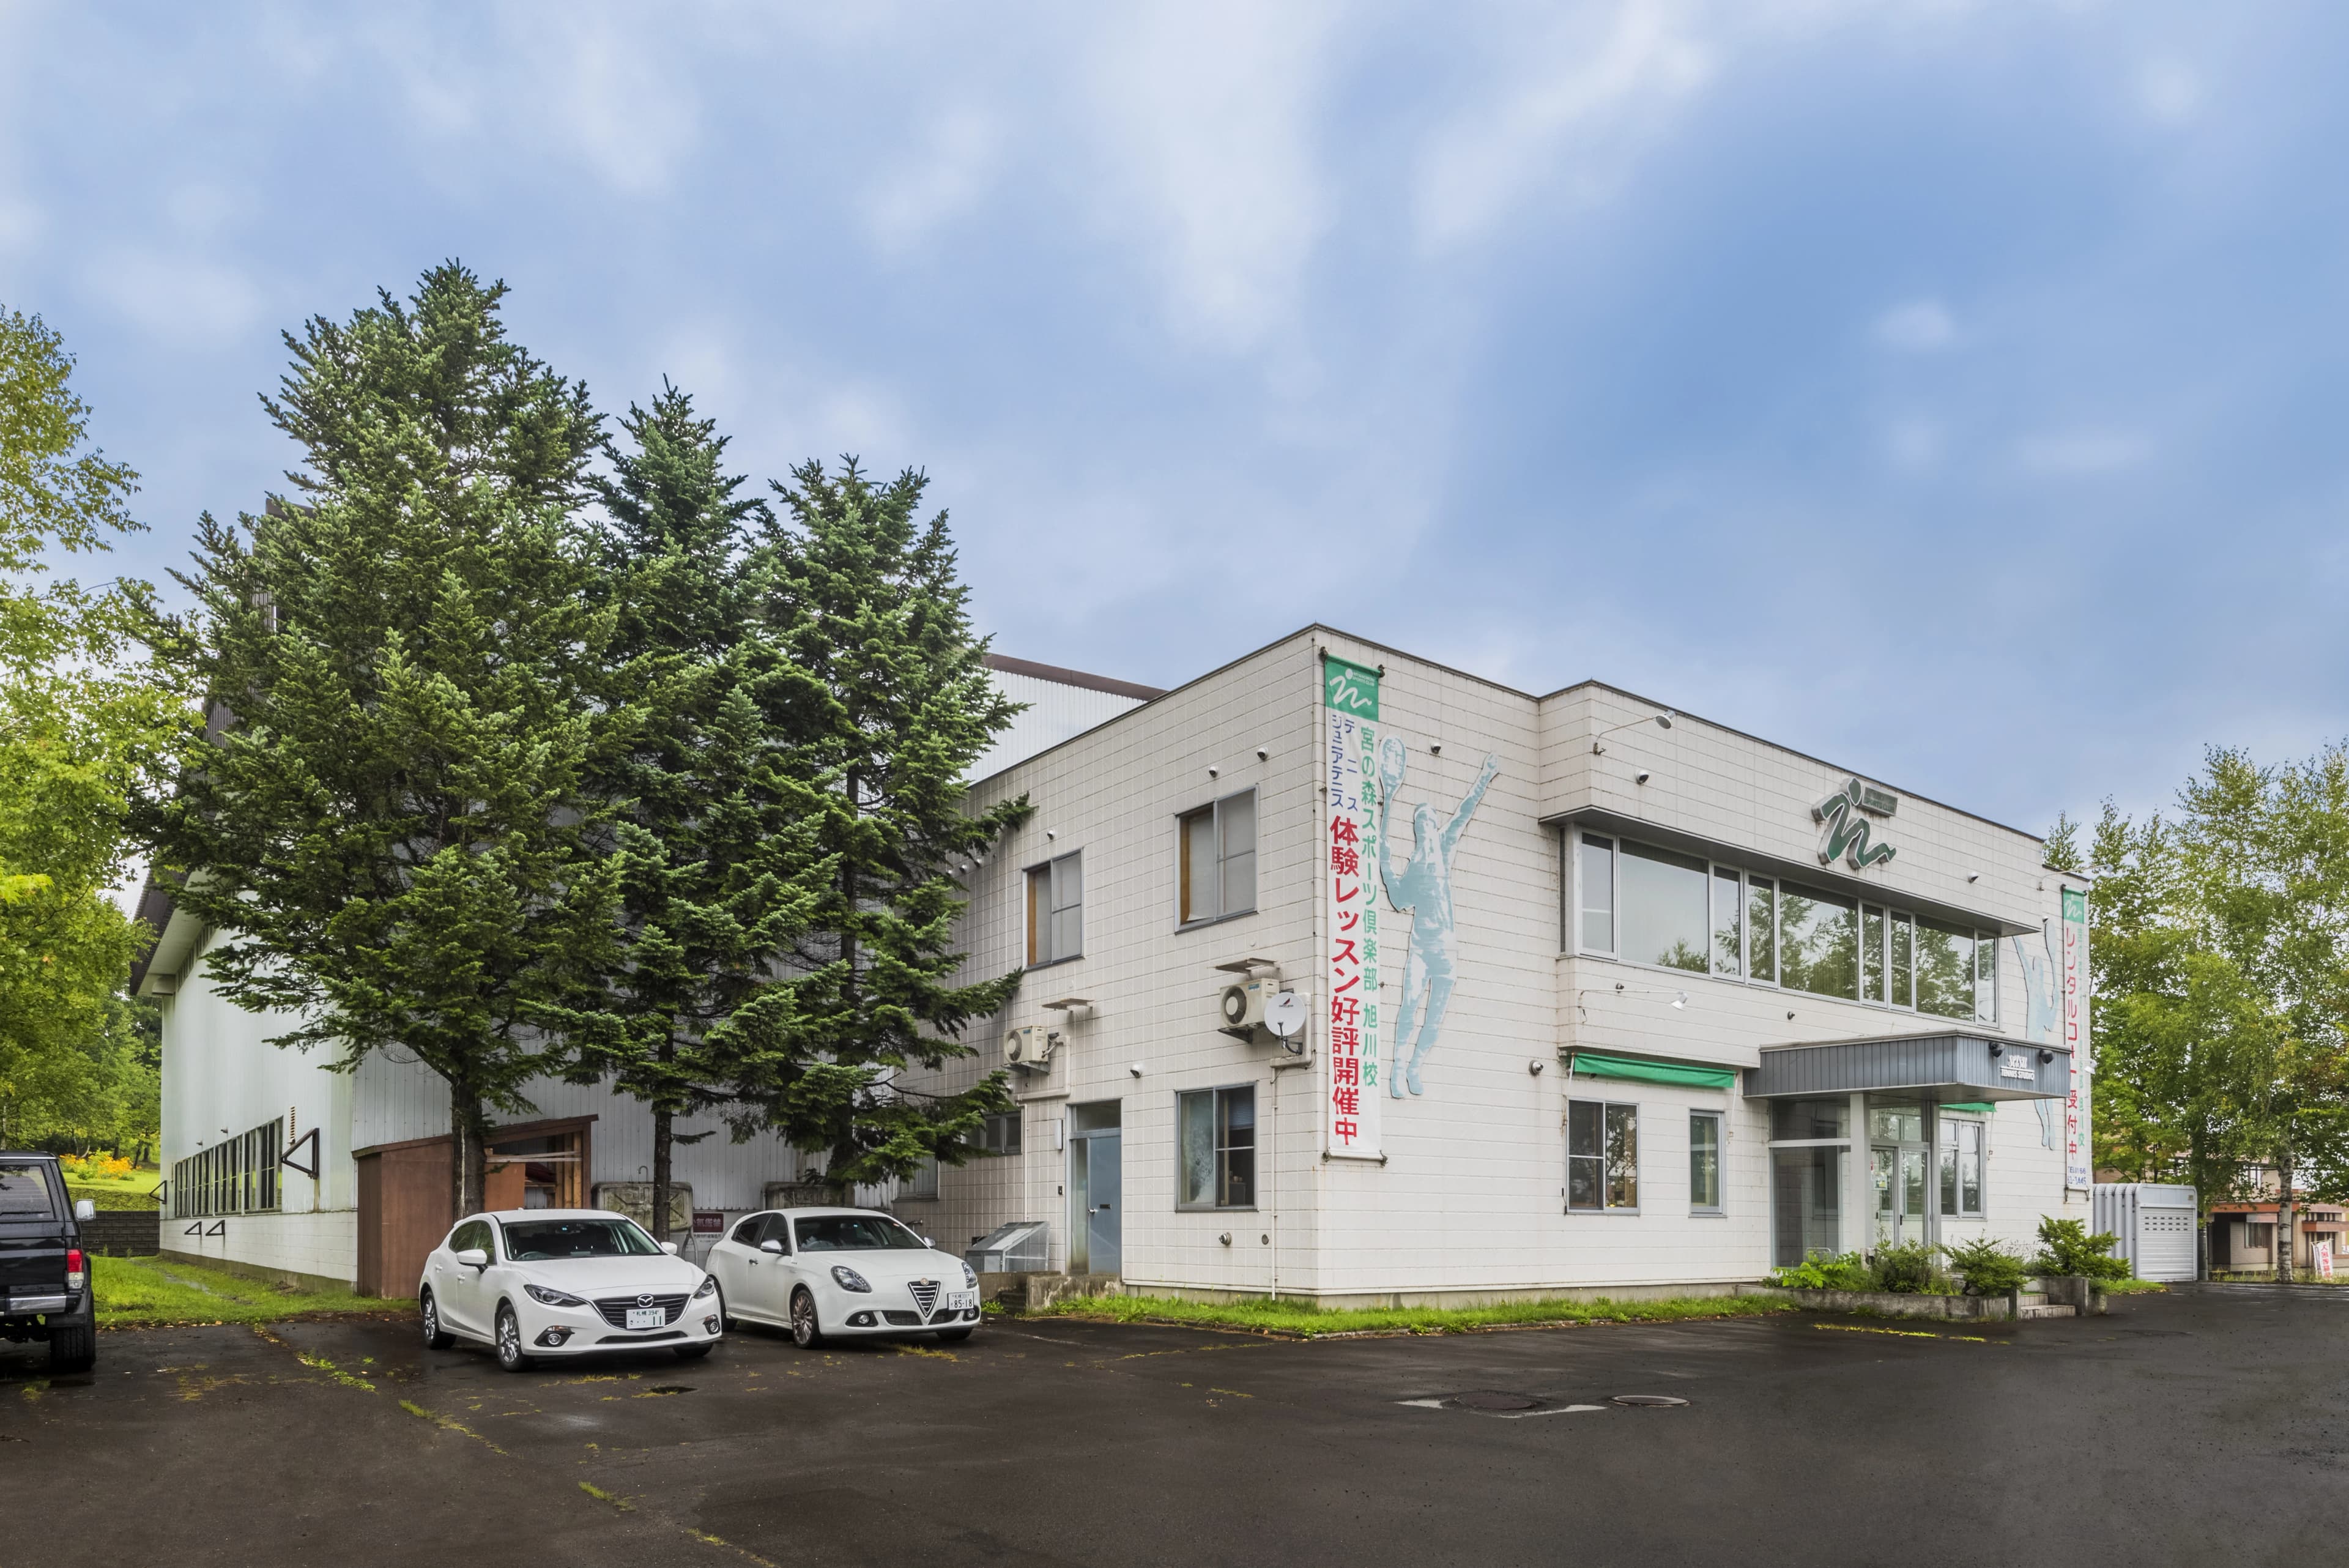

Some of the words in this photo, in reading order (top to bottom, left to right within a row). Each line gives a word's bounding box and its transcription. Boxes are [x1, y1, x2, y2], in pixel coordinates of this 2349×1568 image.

[1331, 715, 1343, 808] ジュニアテニス
[1345, 719, 1358, 812] テニス
[1361, 726, 1378, 992] 宮の森スポーツ倶楽部
[1330, 815, 1360, 1146] 体験レッスン好評開催中
[1362, 1003, 1378, 1087] 旭川校
[2001, 1069, 2017, 1078] TENNIS
[2017, 1071, 2035, 1080] STUDIO
[954, 1299, 973, 1308] 85-18
